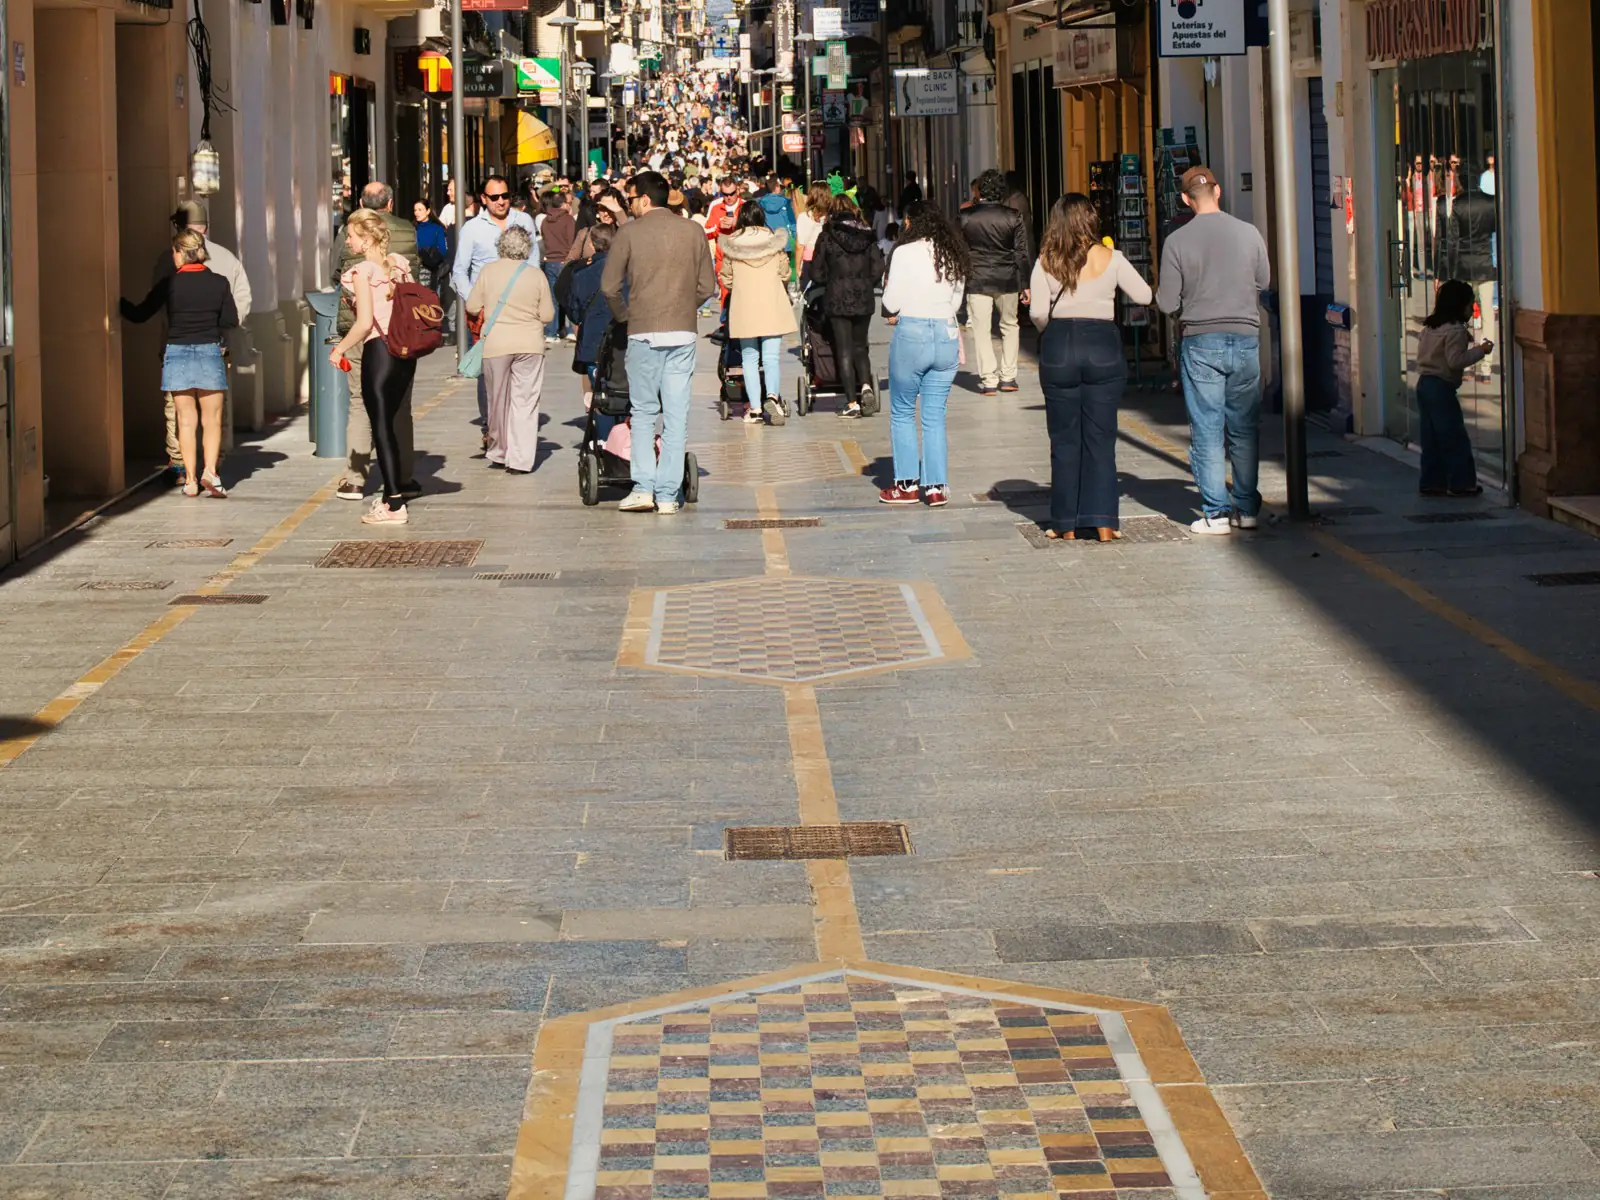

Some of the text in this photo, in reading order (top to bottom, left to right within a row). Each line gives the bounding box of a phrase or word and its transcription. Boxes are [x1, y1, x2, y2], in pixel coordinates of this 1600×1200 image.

[1171, 20, 1213, 31] Loterías y
[1172, 30, 1226, 40] Apuestas del
[1172, 41, 1201, 49] Estado
[465, 65, 494, 74] PUNT
[918, 71, 953, 80] THE BACK
[464, 83, 495, 92] ROMA
[924, 83, 947, 92] CLINIC
